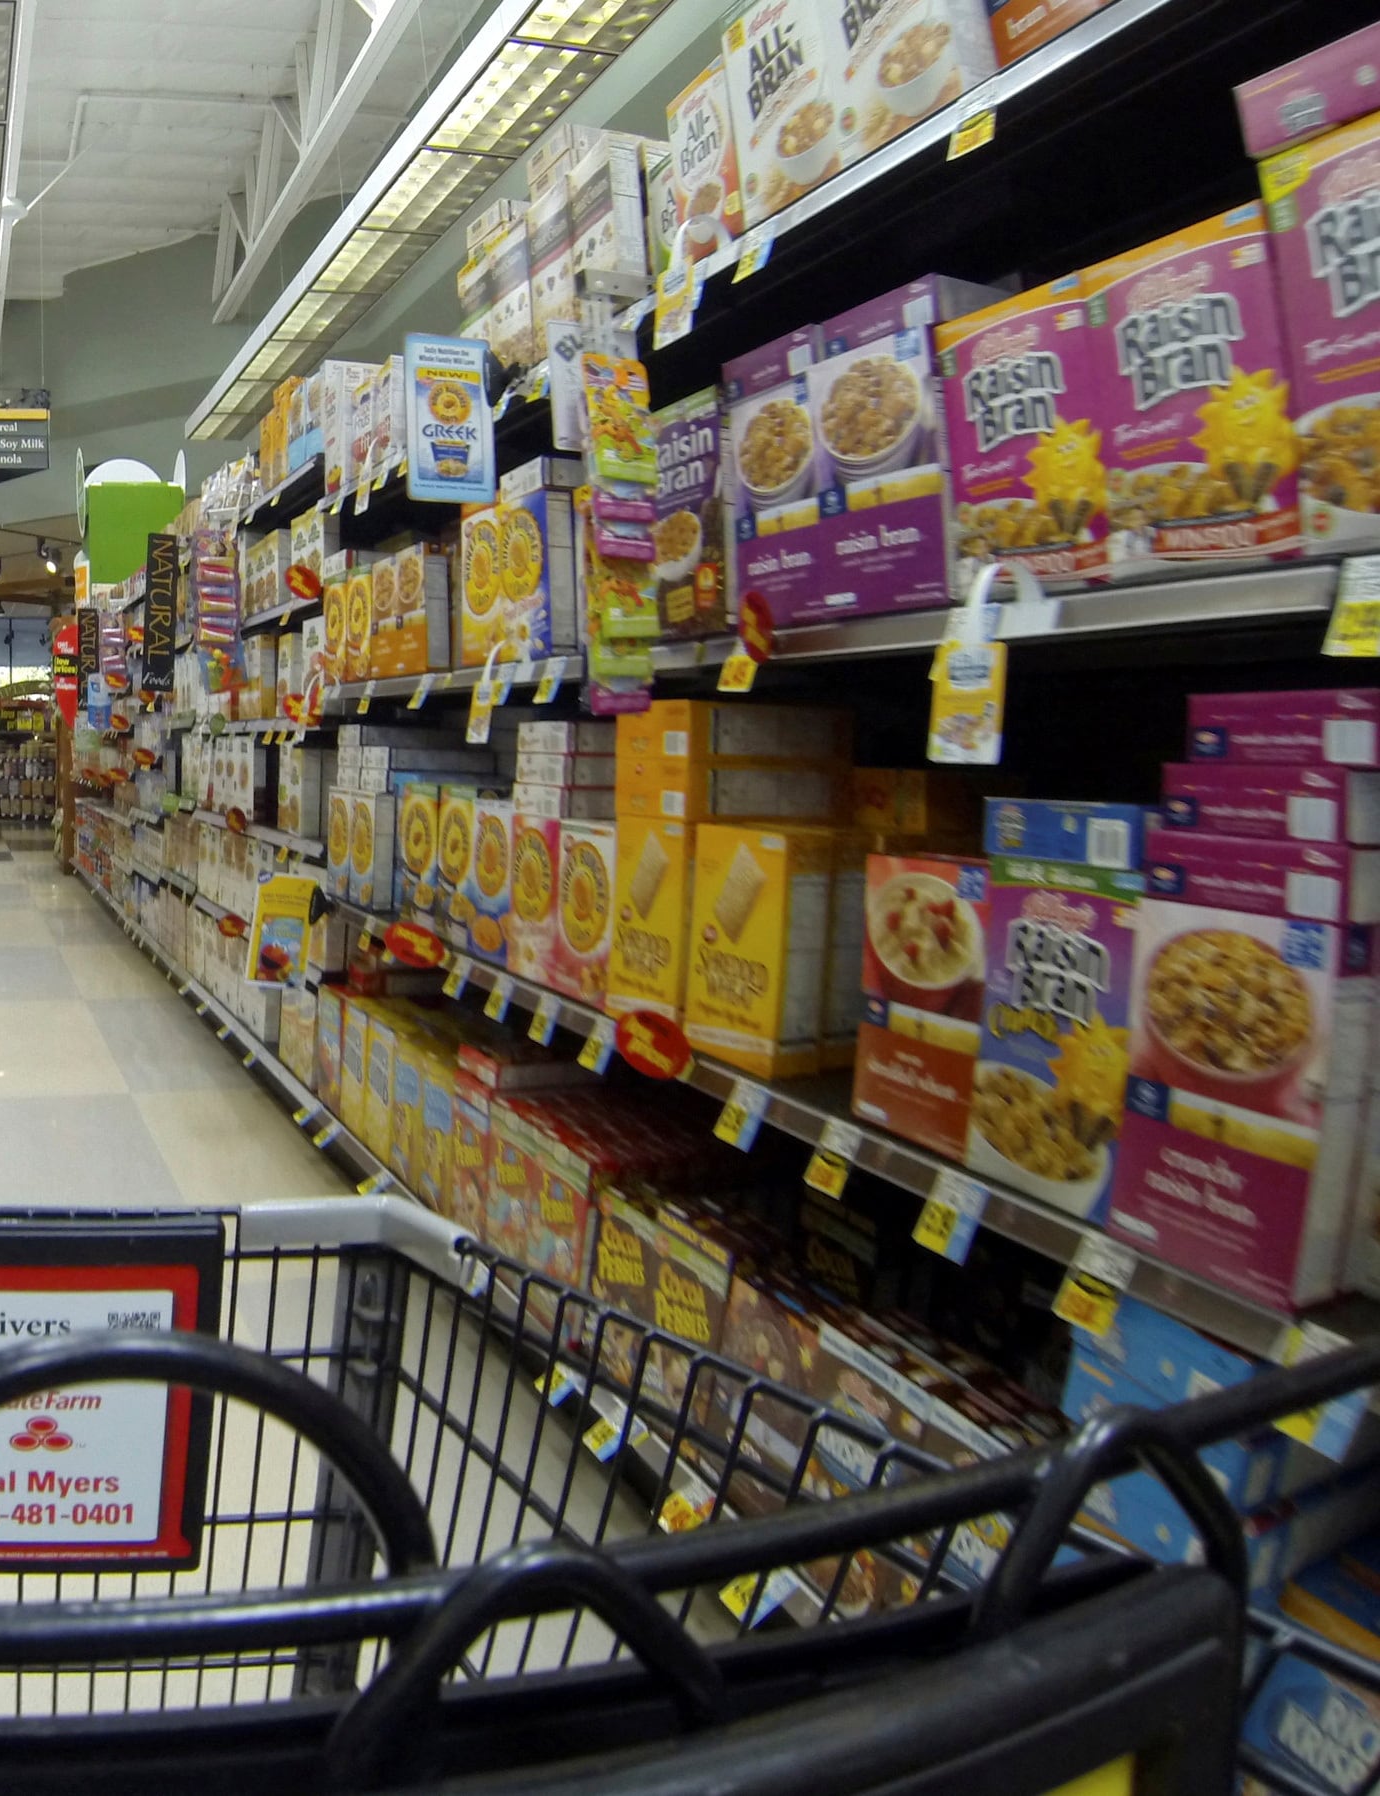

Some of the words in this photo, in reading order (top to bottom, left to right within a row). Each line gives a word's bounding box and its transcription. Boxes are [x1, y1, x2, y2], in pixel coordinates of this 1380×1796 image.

[747, 39, 805, 121] BRAN
[680, 131, 718, 178] Bran
[1115, 293, 1245, 376] Raisin
[426, 370, 469, 379] NEW!
[963, 351, 1067, 422] Raisin
[1132, 341, 1234, 411] Bran
[0, 438, 19, 451] Soy
[21, 438, 45, 449] Milk
[422, 423, 477, 441] GREEK
[656, 425, 713, 470] aisin
[977, 391, 1057, 453] Bran
[147, 538, 174, 665] NATURAL
[27, 1470, 120, 1499] Myers
